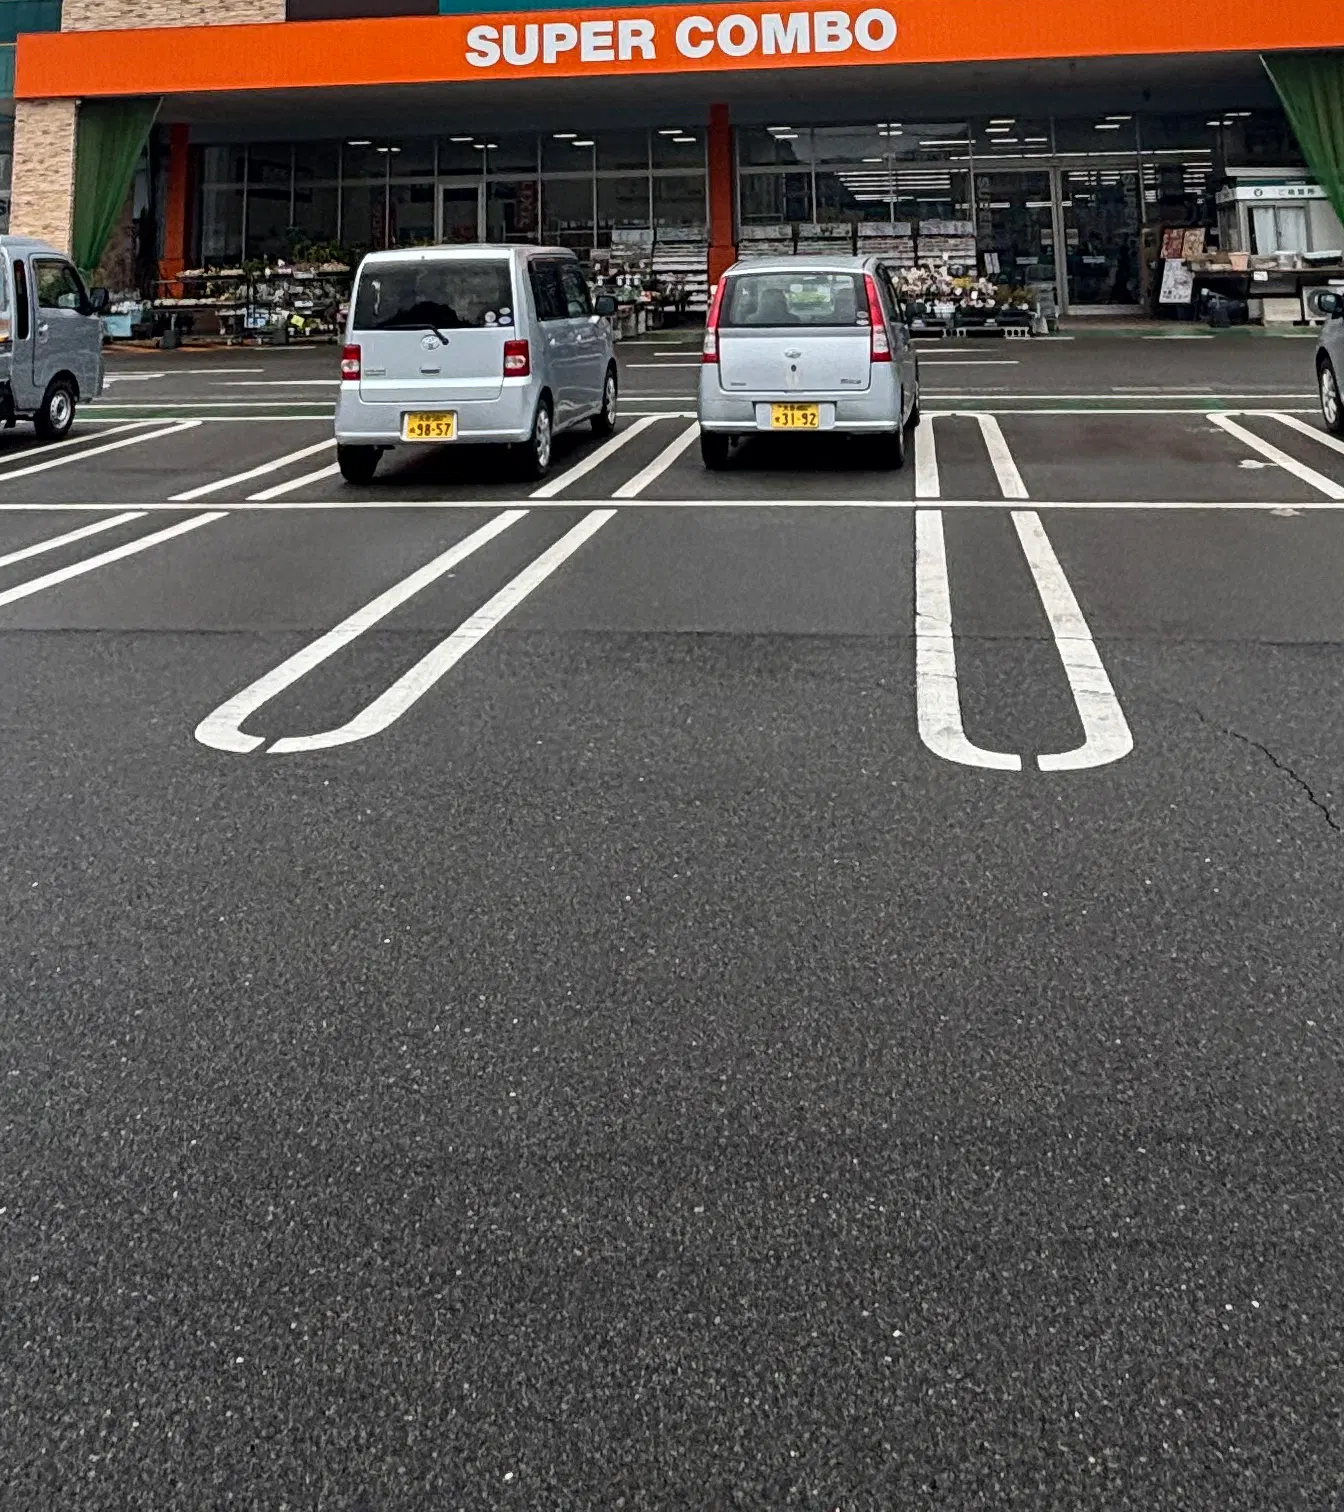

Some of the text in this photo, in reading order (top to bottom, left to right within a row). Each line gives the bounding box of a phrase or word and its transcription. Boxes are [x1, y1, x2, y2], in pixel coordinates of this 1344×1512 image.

[465, 8, 898, 67] SUPER COMBO
[782, 412, 817, 426] 31-92
[416, 422, 452, 437] 98-57
